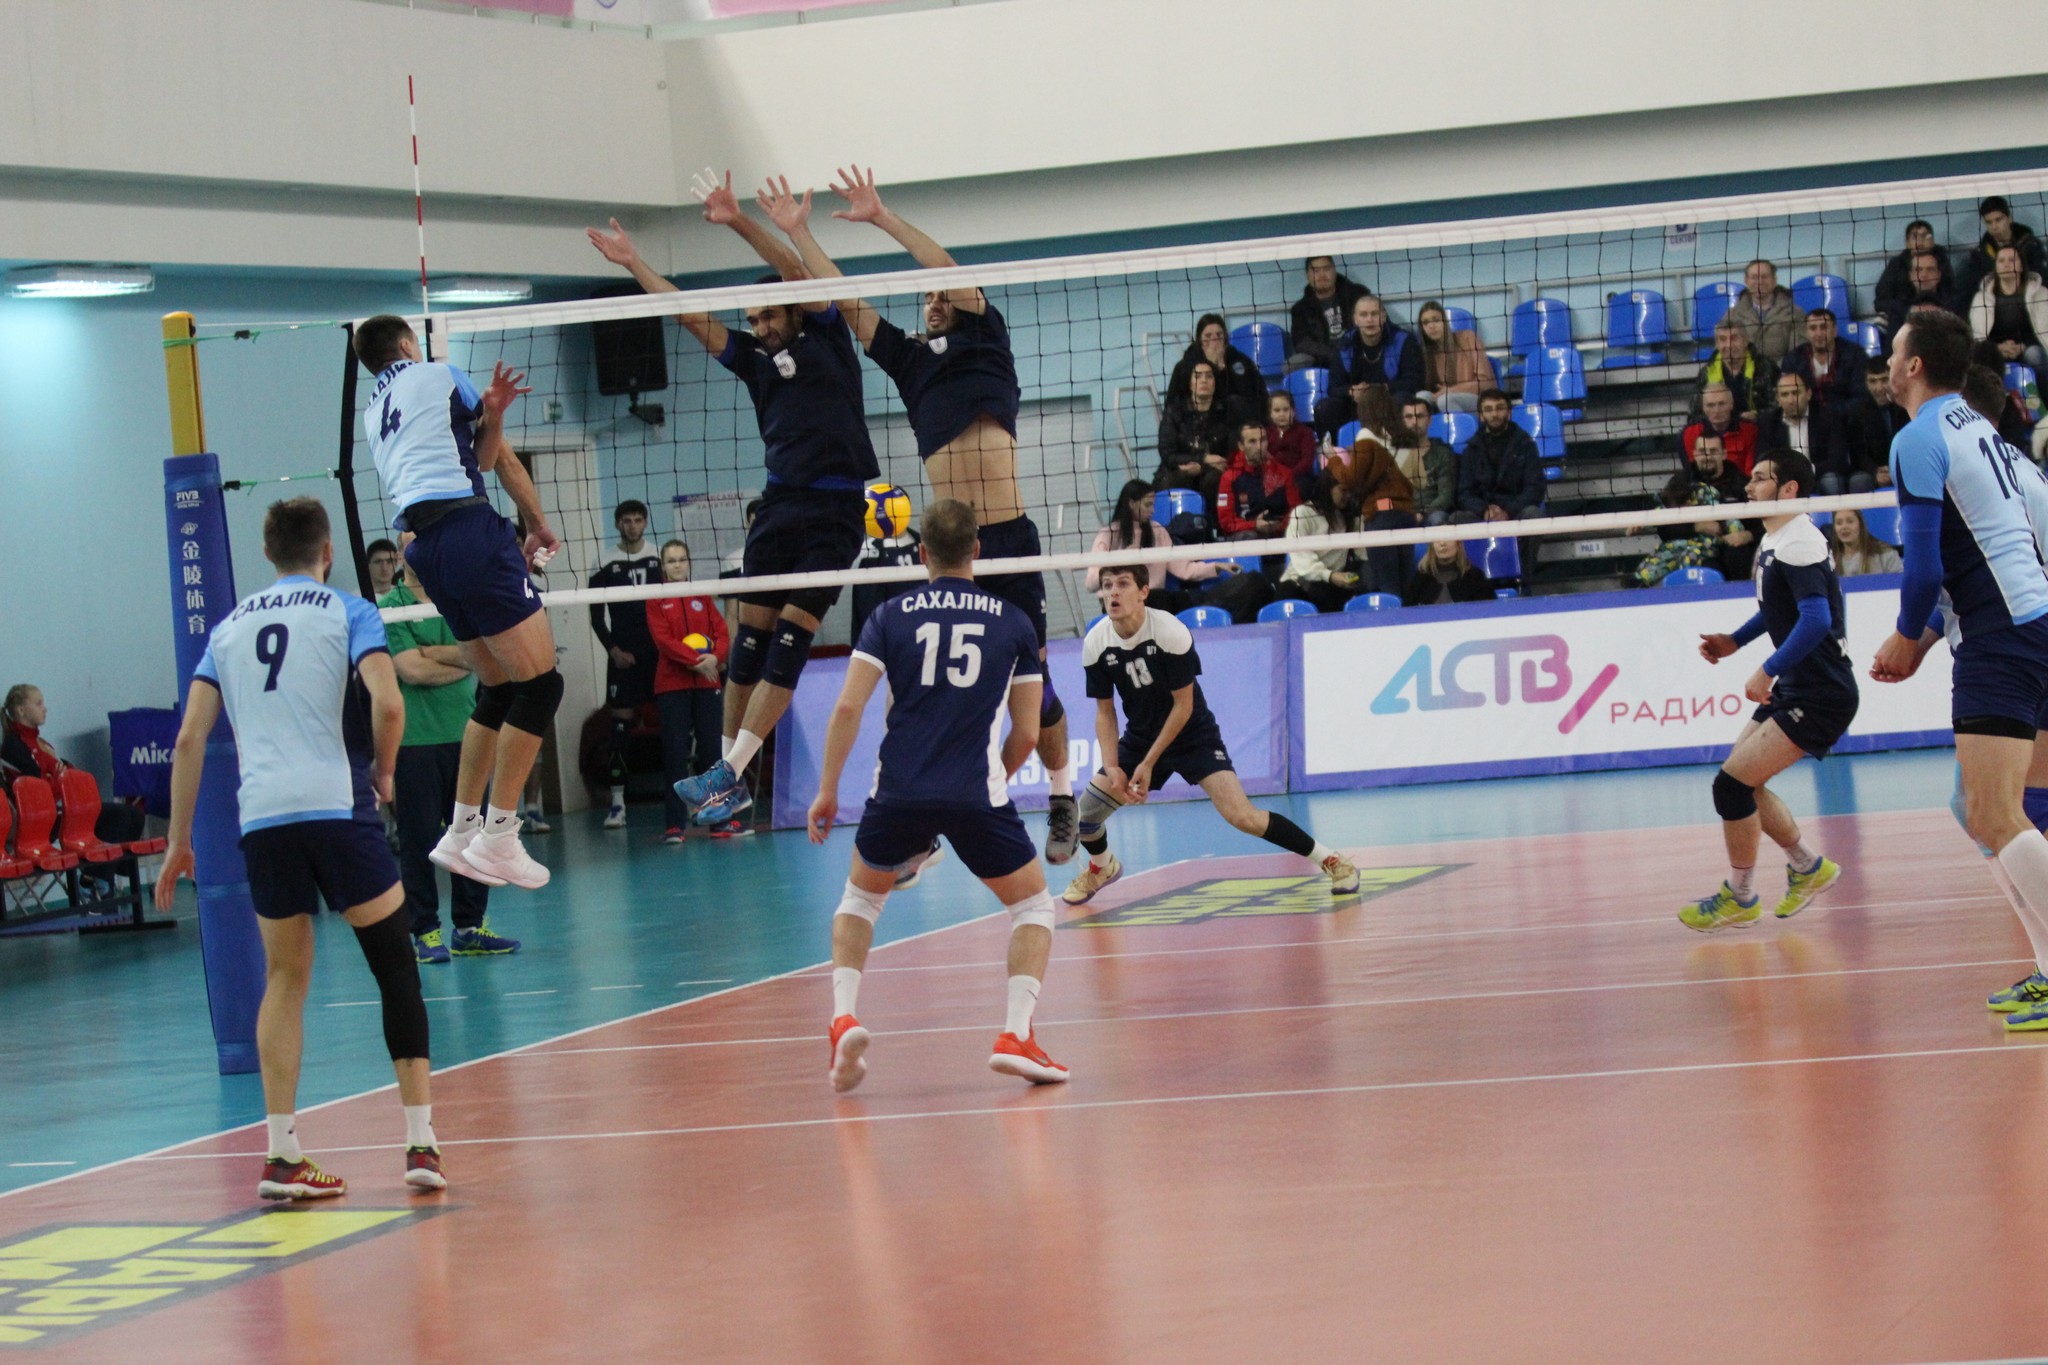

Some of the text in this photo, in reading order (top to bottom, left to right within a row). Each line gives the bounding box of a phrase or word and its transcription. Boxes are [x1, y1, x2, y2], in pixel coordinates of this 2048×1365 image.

[773, 349, 797, 379] 5
[380, 391, 402, 442] 4
[1979, 433, 2025, 500] 18
[176, 490, 199, 502] FIVB
[182, 540, 206, 635] 金陵体育
[232, 590, 332, 622] САХАЛИН
[901, 590, 1003, 616] САХАЛИН
[256, 623, 289, 692] 9
[916, 621, 985, 688] 15
[1125, 657, 1154, 689] 13
[1370, 634, 1573, 715] АСТВ
[1611, 694, 1742, 726] РАДИО
